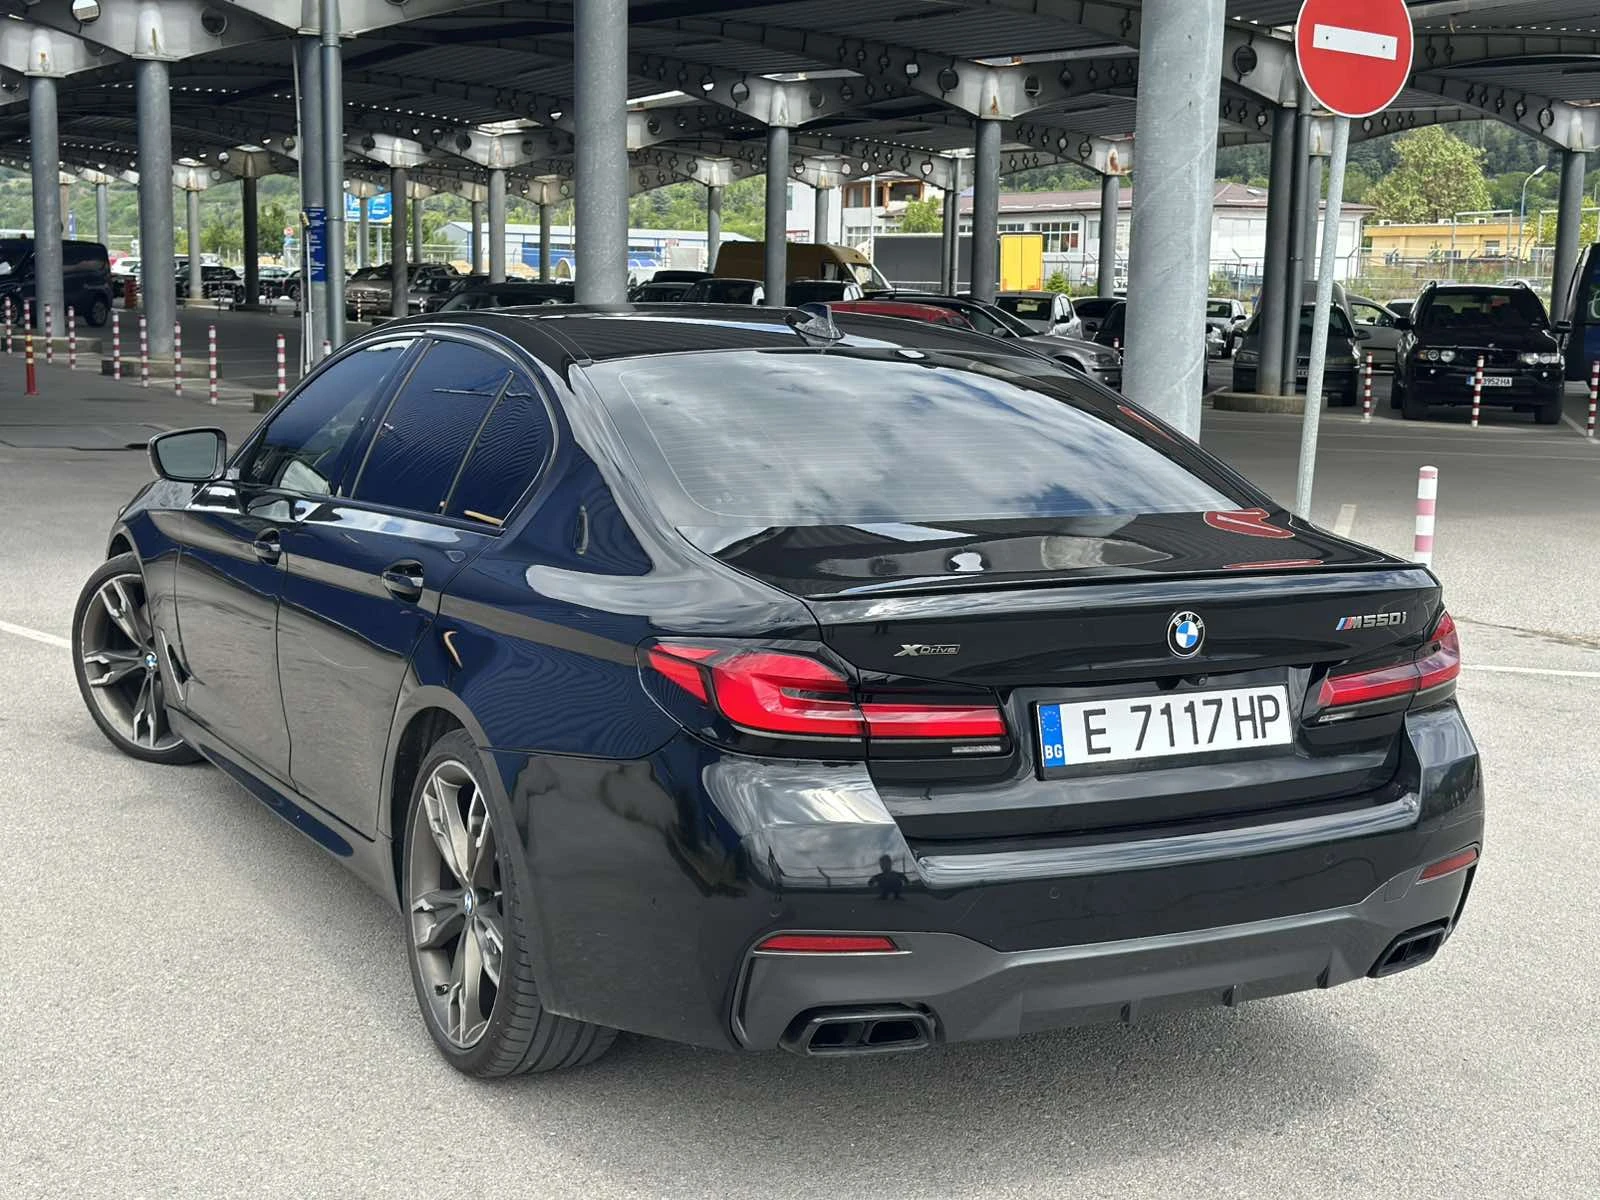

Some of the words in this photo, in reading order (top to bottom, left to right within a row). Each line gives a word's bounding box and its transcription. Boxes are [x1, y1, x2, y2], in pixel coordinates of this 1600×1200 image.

[1082, 707, 1112, 756] E
[1130, 698, 1223, 752] 7117
[1232, 694, 1280, 740] HP
[1044, 744, 1063, 759] BG
